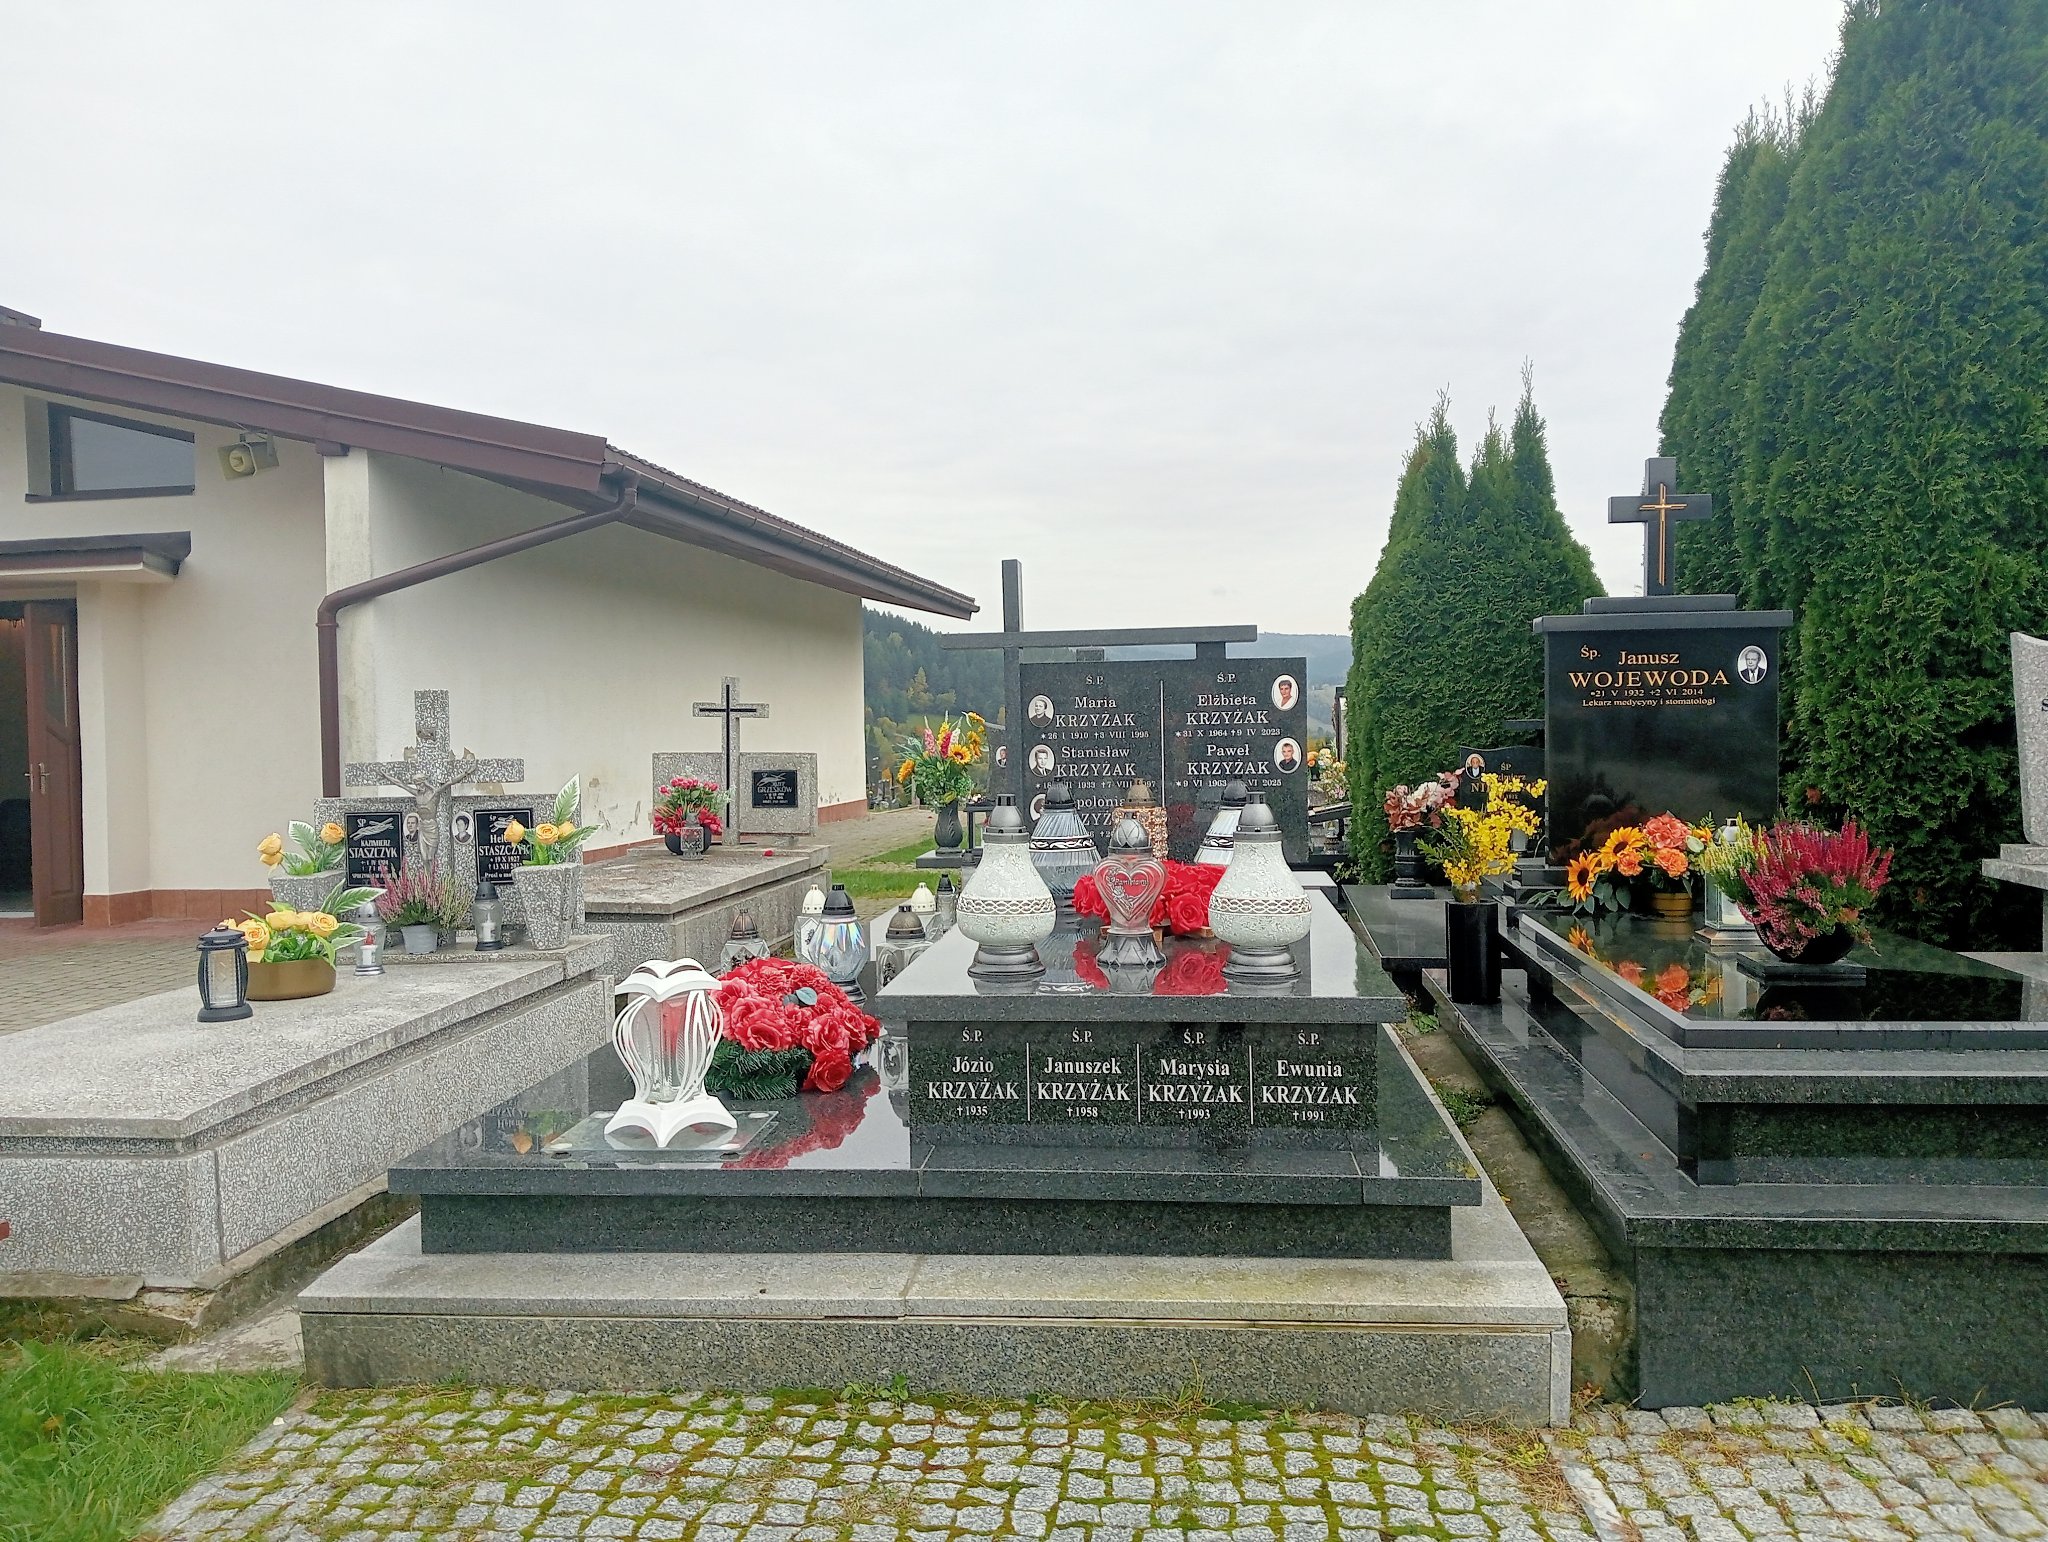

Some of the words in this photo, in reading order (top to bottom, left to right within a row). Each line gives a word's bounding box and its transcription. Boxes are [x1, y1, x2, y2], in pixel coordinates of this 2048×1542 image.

[1618, 650, 1680, 665] Janusz
[1568, 669, 1730, 688] WOJEWODA
[1197, 694, 1257, 706] Elżbieta
[1682, 688, 1703, 696] 2014
[1074, 696, 1117, 708] Maria
[1582, 699, 1612, 707] Lekarz
[1055, 711, 1136, 727] KRZYŻAK
[1186, 709, 1269, 725] KRZYŻAK
[1071, 732, 1089, 740] 1910
[1209, 729, 1228, 737] 1964
[1061, 745, 1130, 758] Stanisław
[1206, 744, 1250, 756] Paweł
[1056, 761, 1136, 777] KRZYŻAK
[1187, 759, 1270, 775] KRZYŻAK
[349, 847, 398, 859] STASZCZYK
[952, 1056, 994, 1074] Józio
[1044, 1057, 1122, 1074] Januszek
[1159, 1058, 1230, 1080] Marysia
[1277, 1059, 1343, 1077] Ewunia
[927, 1077, 1019, 1100] KRZYŻAK
[1037, 1078, 1130, 1101] KRZYŻAK
[1148, 1080, 1244, 1103] KRZYŻAK
[1261, 1082, 1359, 1105] KRZYŻAK
